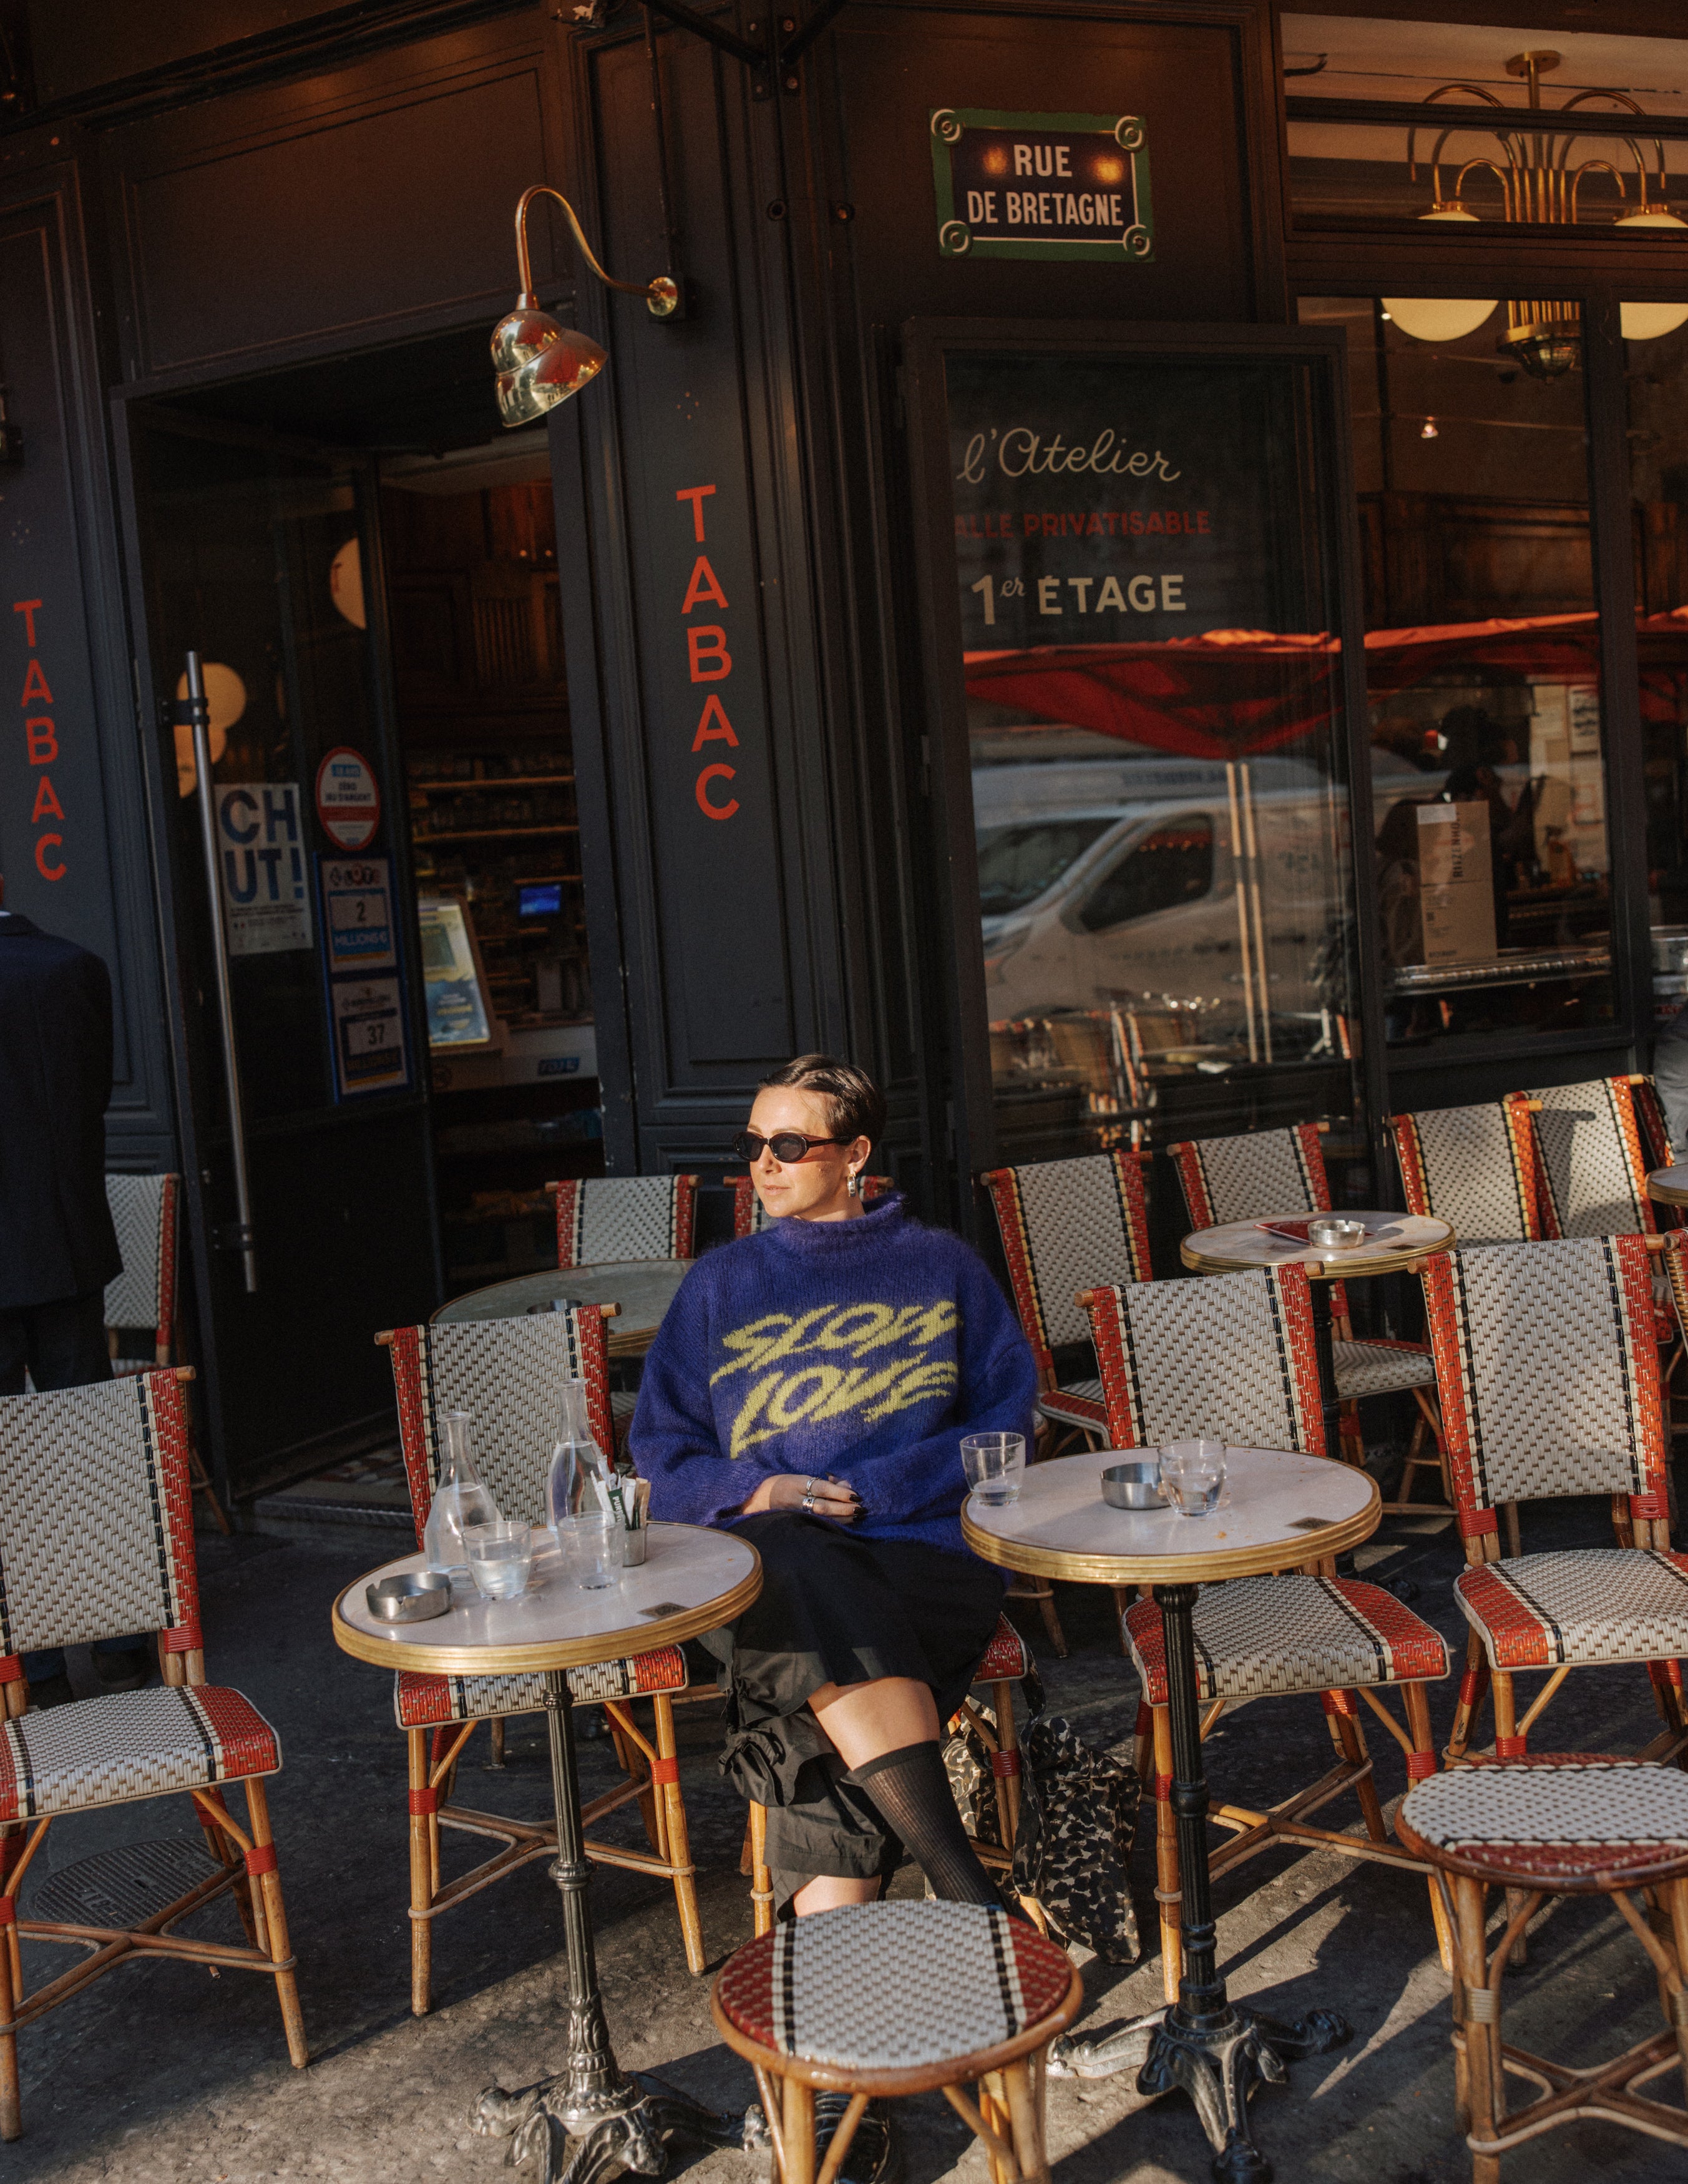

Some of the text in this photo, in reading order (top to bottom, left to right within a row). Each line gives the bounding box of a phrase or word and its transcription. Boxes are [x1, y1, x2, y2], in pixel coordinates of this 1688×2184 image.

[1013, 144, 1073, 177] RUE
[967, 190, 1124, 226] DE BRETAGNE
[956, 427, 1181, 484] l'Atelier
[1023, 510, 1211, 538] PRIVATISABLE
[971, 574, 1027, 625] 1er
[676, 484, 740, 821] TABAC
[14, 599, 67, 882] TABAC
[221, 790, 298, 844] CH
[225, 847, 304, 903] UT!
[356, 901, 366, 922] 2
[367, 1024, 384, 1045] 37
